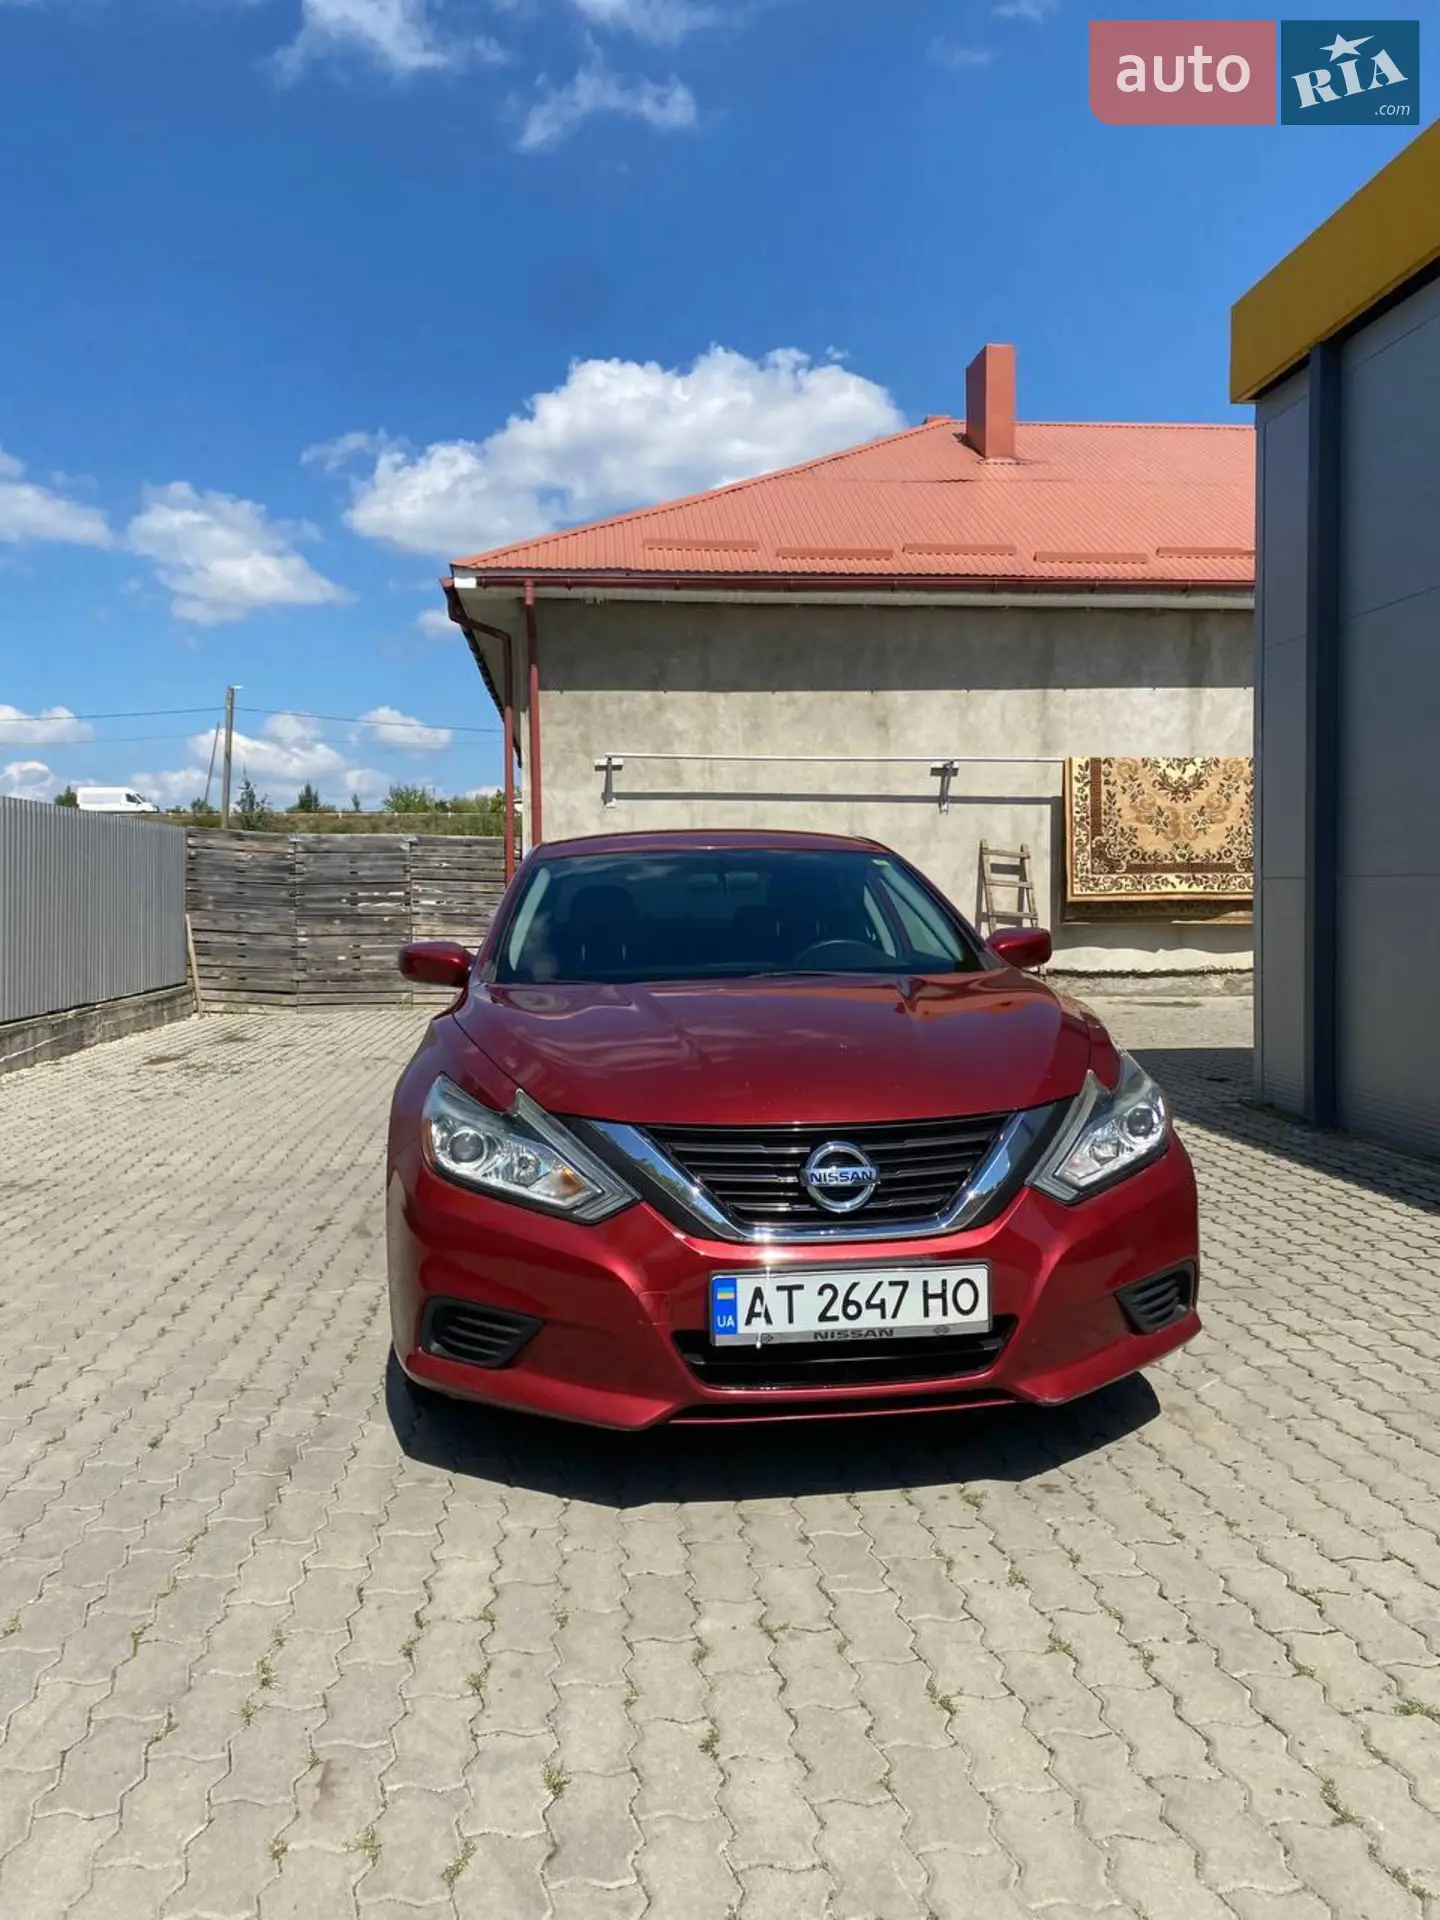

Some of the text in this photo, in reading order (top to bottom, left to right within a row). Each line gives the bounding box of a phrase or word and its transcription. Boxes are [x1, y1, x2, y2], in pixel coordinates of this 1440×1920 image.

[809, 1171, 873, 1183] NISSAN
[745, 1277, 980, 1326] AT 2647 HO
[717, 1315, 735, 1328] UA
[813, 1327, 894, 1341] NISSAN
